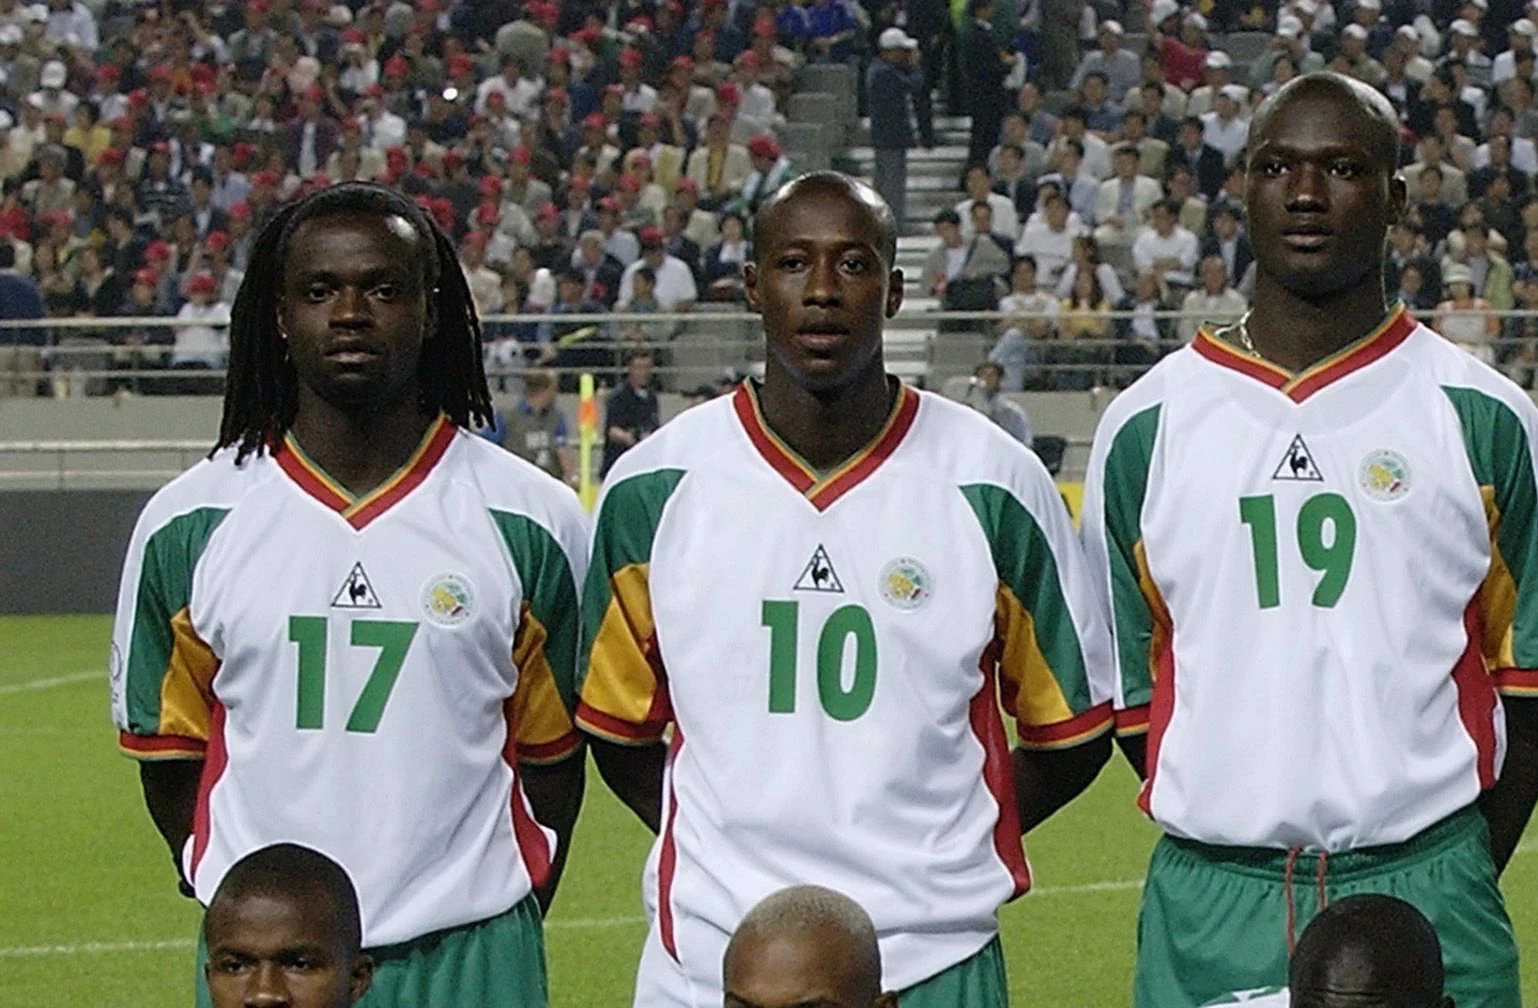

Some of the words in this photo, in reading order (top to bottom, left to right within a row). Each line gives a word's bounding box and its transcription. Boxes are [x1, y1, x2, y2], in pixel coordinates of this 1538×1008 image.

[1239, 492, 1357, 609] 19
[287, 615, 419, 734] 17
[761, 599, 878, 722] 10
